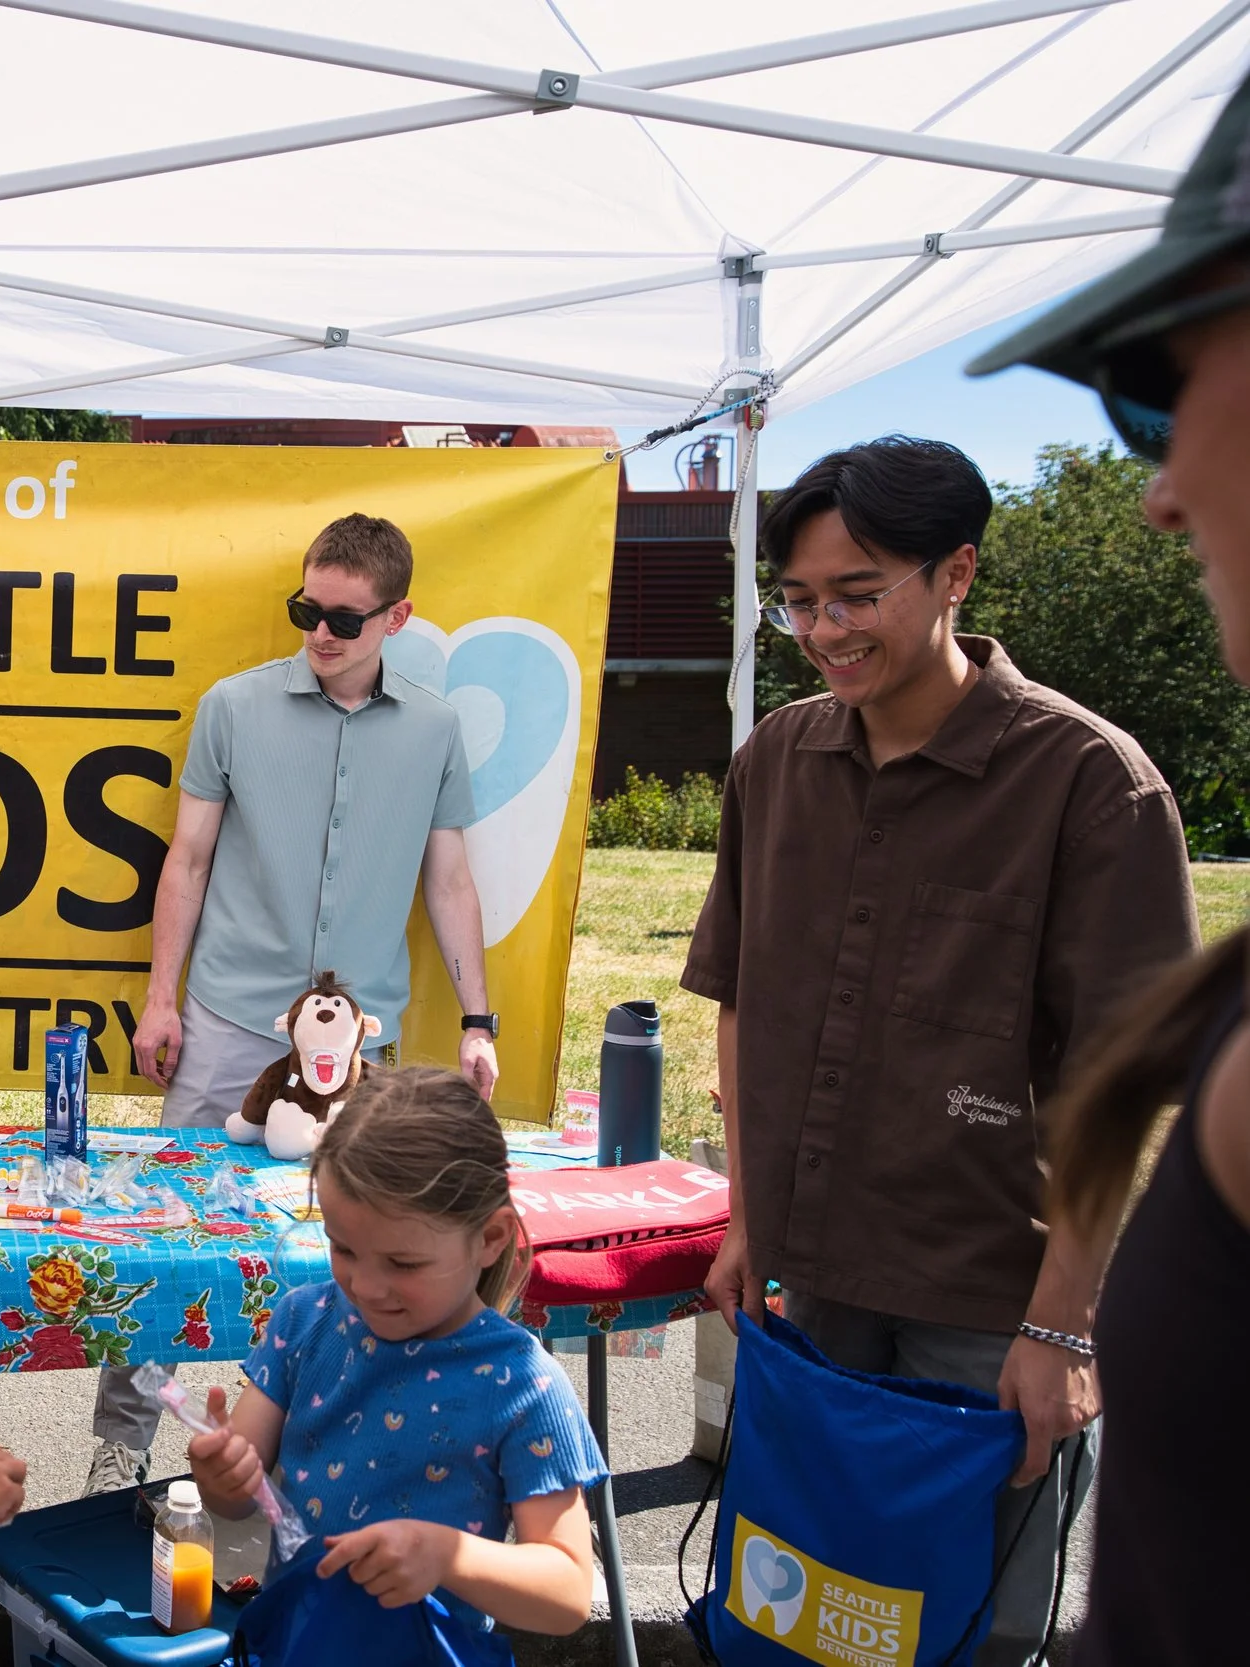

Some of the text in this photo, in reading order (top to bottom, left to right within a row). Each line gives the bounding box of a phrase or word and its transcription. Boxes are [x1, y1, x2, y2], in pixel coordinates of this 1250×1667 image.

[4, 460, 78, 520] of
[387, 1042, 396, 1067] OFF
[946, 1085, 1023, 1117] Worldwide
[967, 1107, 1009, 1126] Goods
[822, 1582, 902, 1619] SEATTLE
[817, 1604, 900, 1655] KIDS
